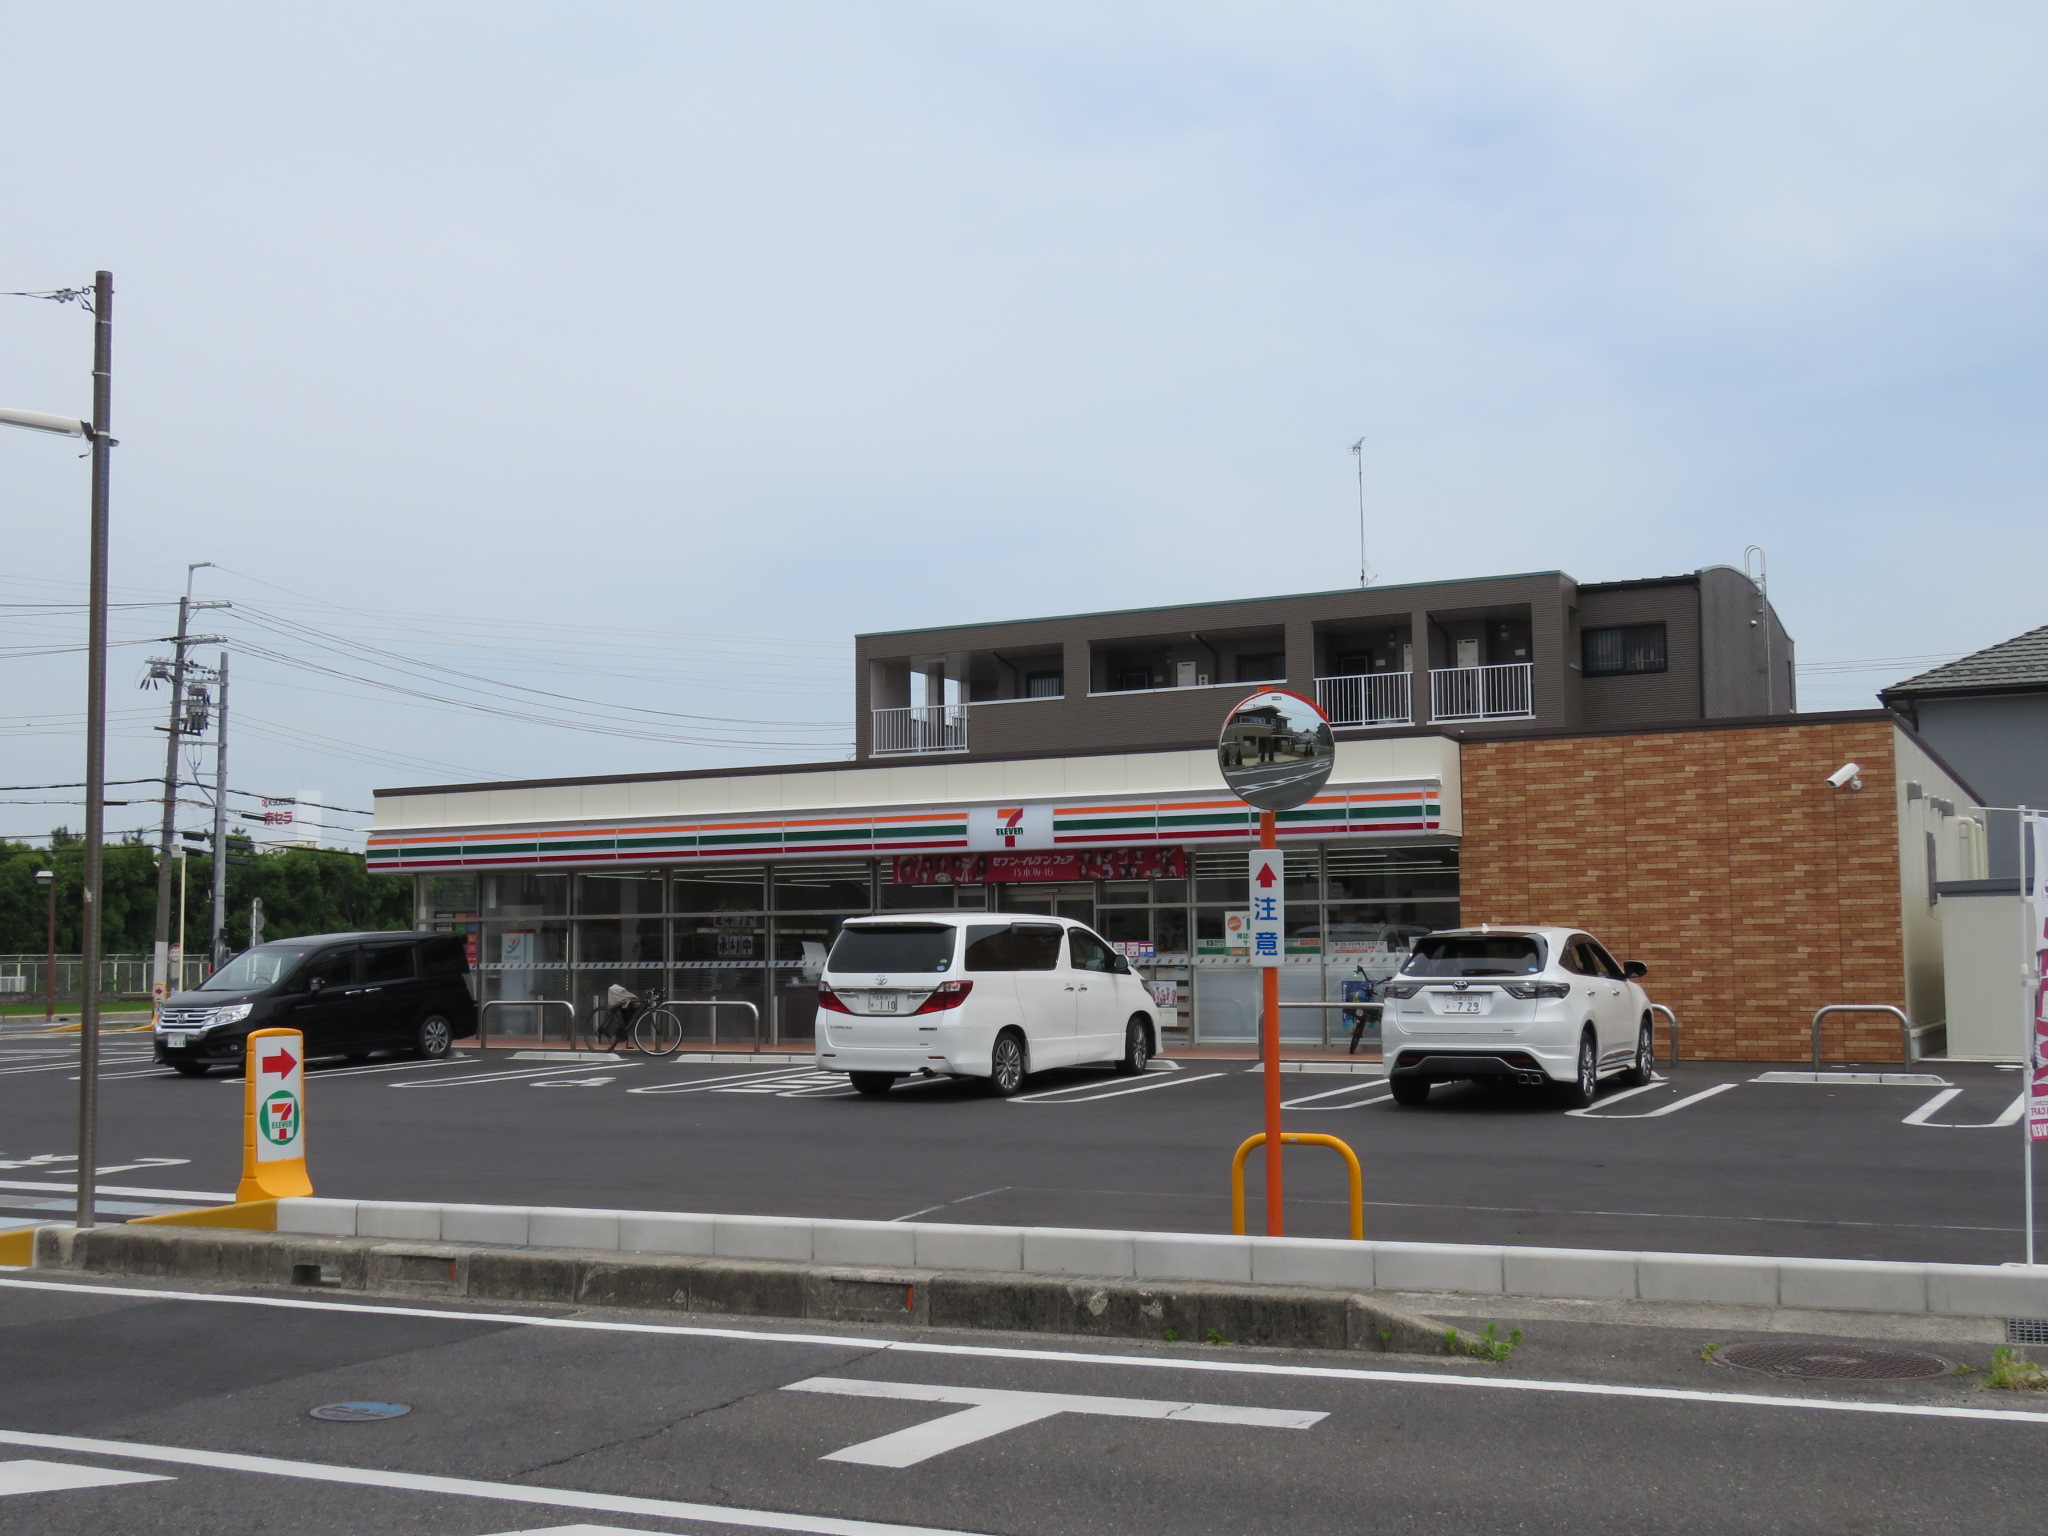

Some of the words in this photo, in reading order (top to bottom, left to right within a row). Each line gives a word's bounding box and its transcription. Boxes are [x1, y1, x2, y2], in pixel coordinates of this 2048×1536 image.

[996, 808, 1024, 848] 7
[1254, 896, 1279, 956] 注意
[271, 1103, 292, 1141] 7
